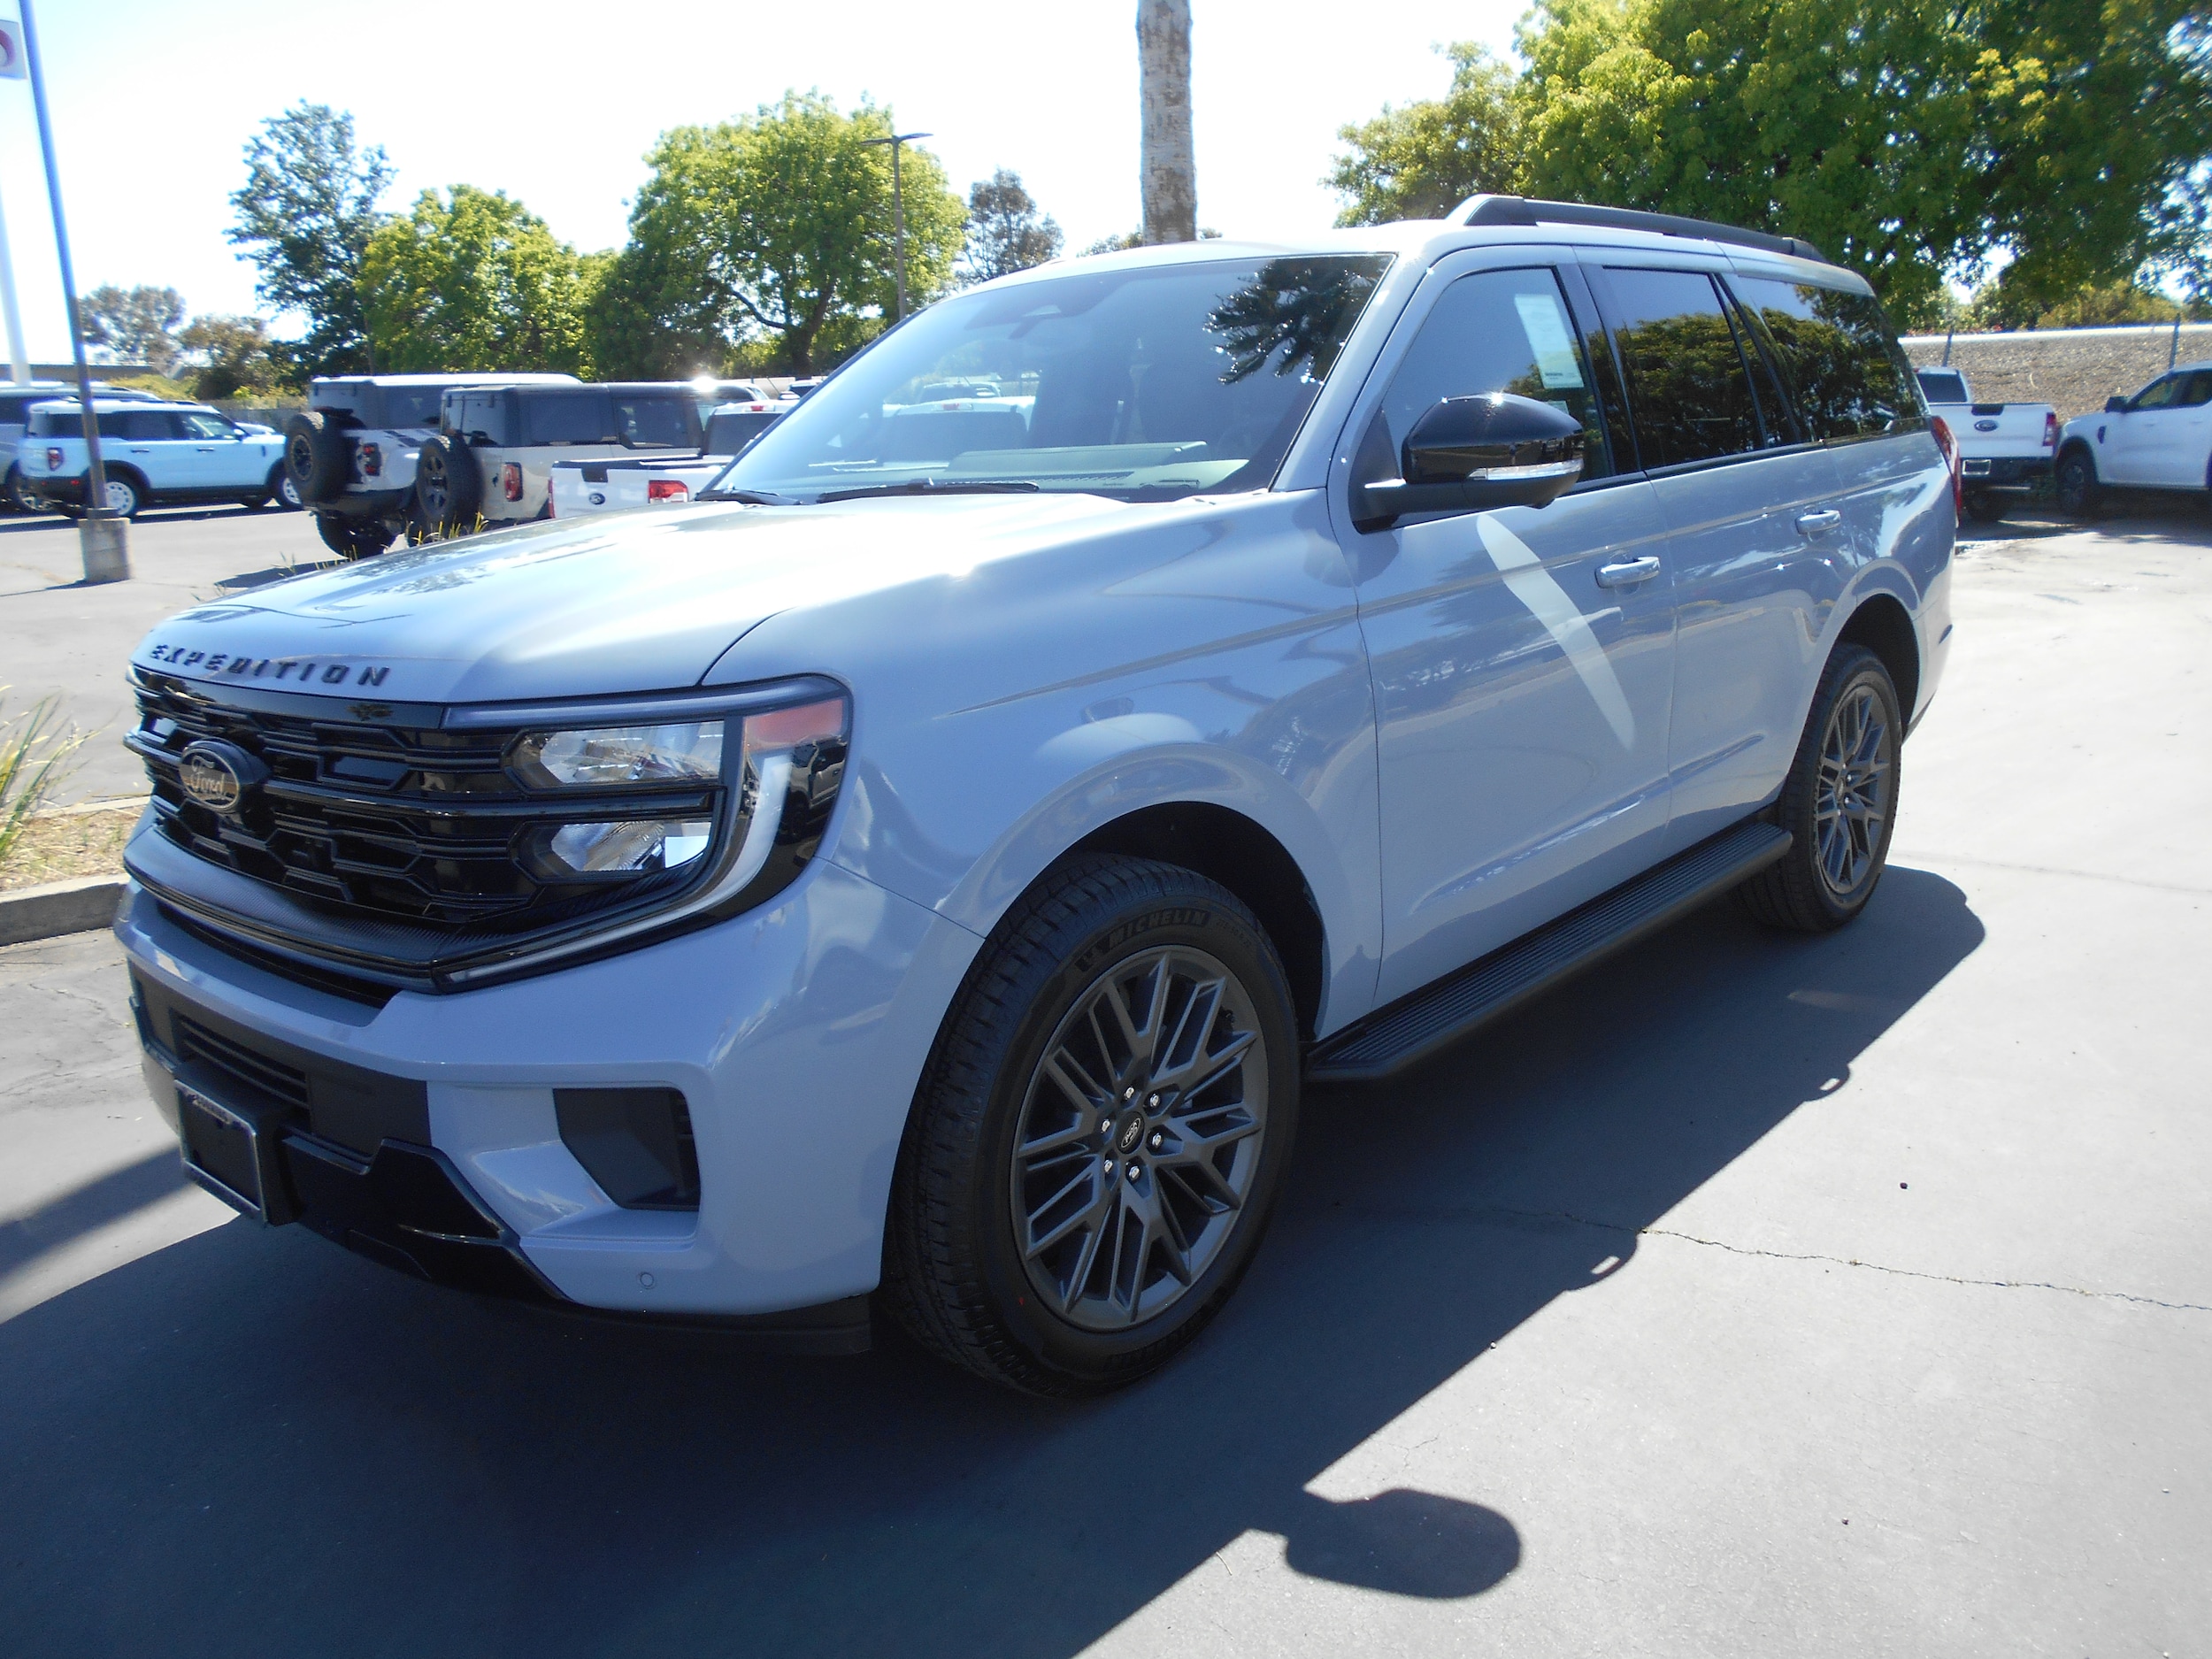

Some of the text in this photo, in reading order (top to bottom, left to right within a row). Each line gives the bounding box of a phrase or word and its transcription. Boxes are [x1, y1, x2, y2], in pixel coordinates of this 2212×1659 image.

[150, 644, 391, 687] EXPEDITION
[189, 754, 228, 795] Ford
[1109, 909, 1207, 949] MICHELIN
